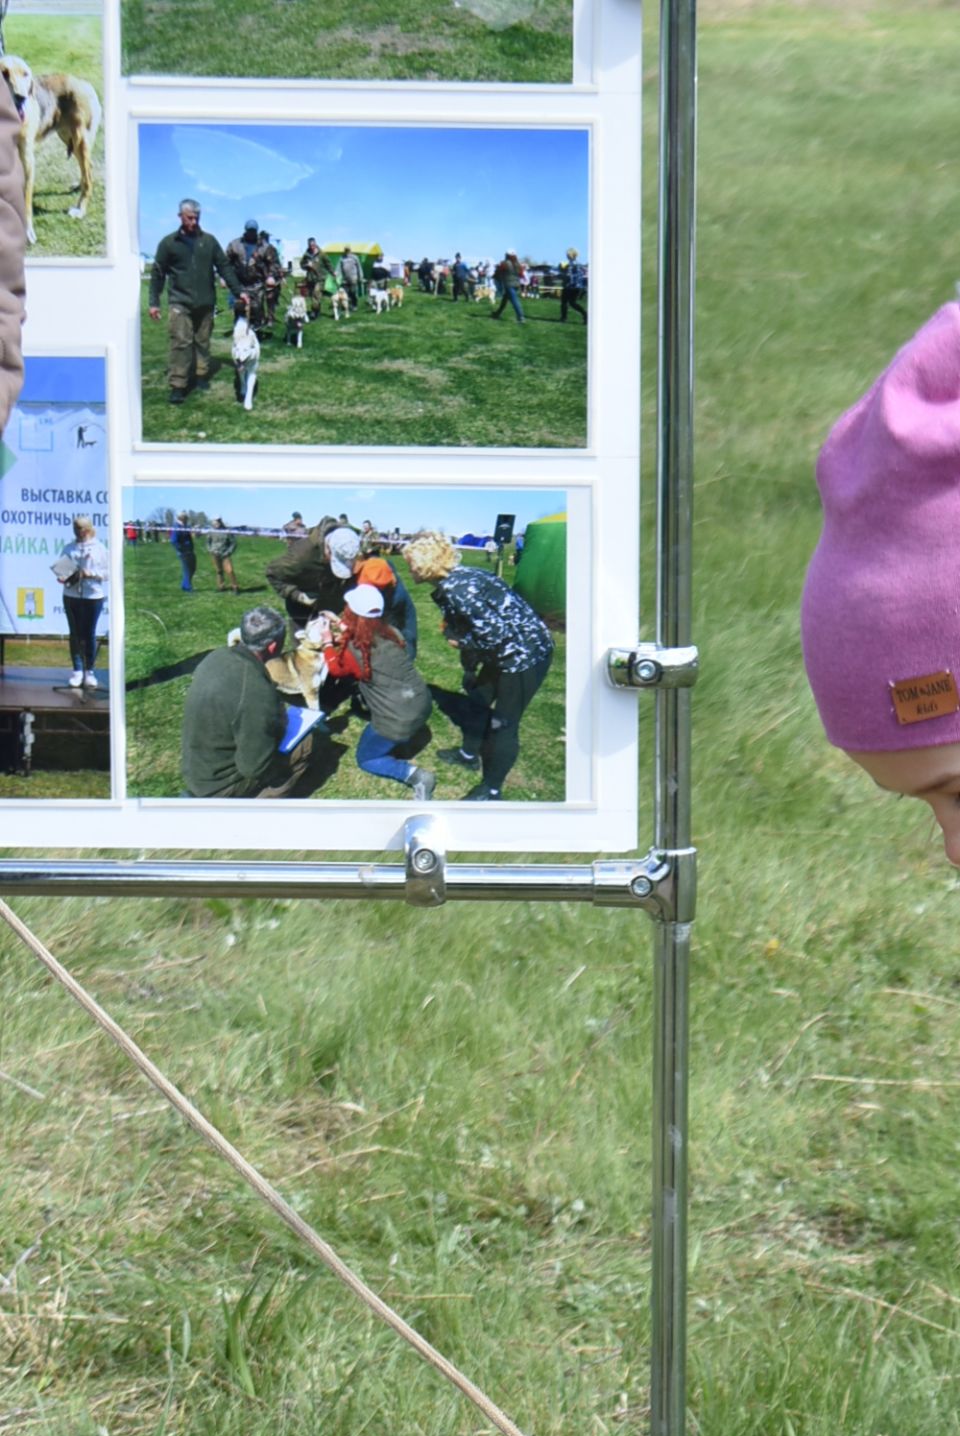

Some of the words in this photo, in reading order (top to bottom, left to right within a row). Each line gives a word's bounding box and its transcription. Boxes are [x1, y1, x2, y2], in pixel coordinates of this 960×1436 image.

[21, 488, 92, 504] ВЫСТАВКА
[1, 510, 90, 527] ОХОТНИЧЬ
[0, 533, 49, 555] АЙКА
